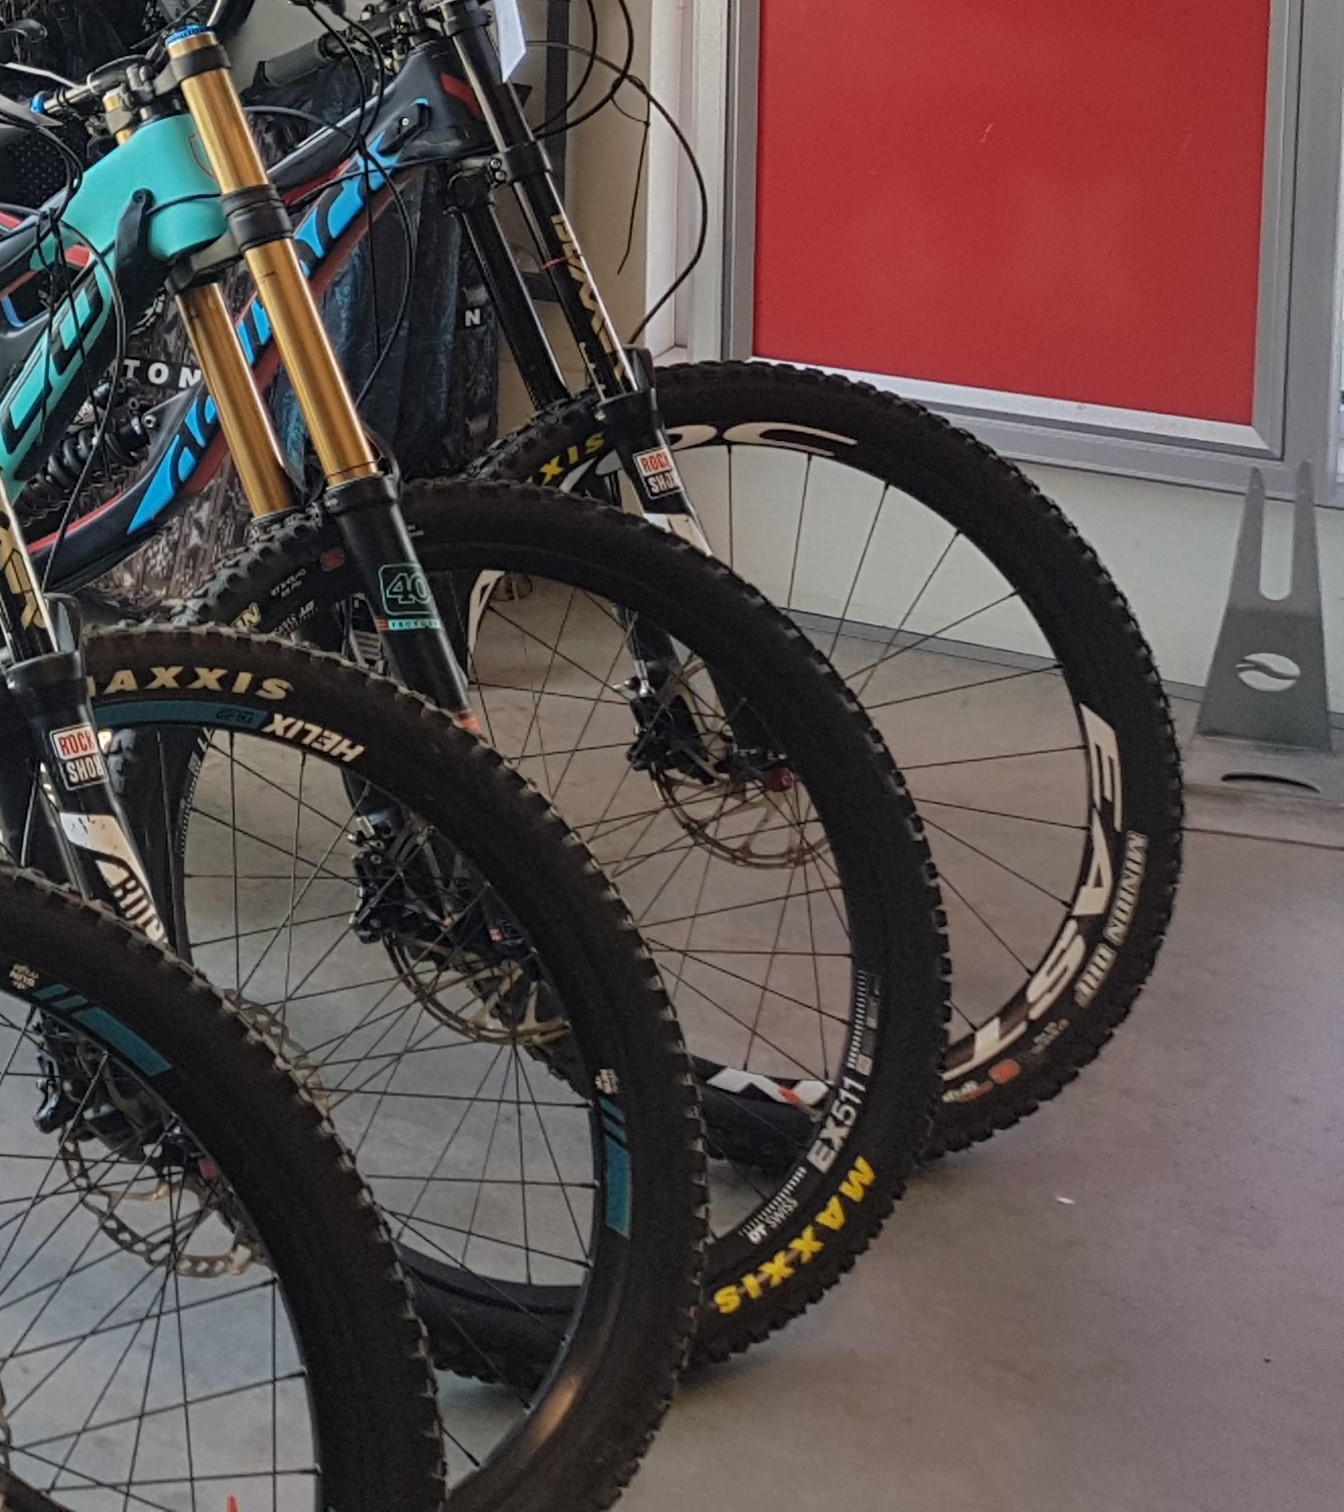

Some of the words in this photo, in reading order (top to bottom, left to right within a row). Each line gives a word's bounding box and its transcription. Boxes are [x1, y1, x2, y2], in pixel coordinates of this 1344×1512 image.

[385, 572, 432, 605] 40
[59, 729, 97, 756] ROCK
[263, 713, 365, 762] HELIX
[66, 757, 106, 784] SHOX
[806, 1074, 867, 1175] EX511
[765, 1197, 800, 1229] SWISS
[713, 1154, 878, 1315] MAXXIS
